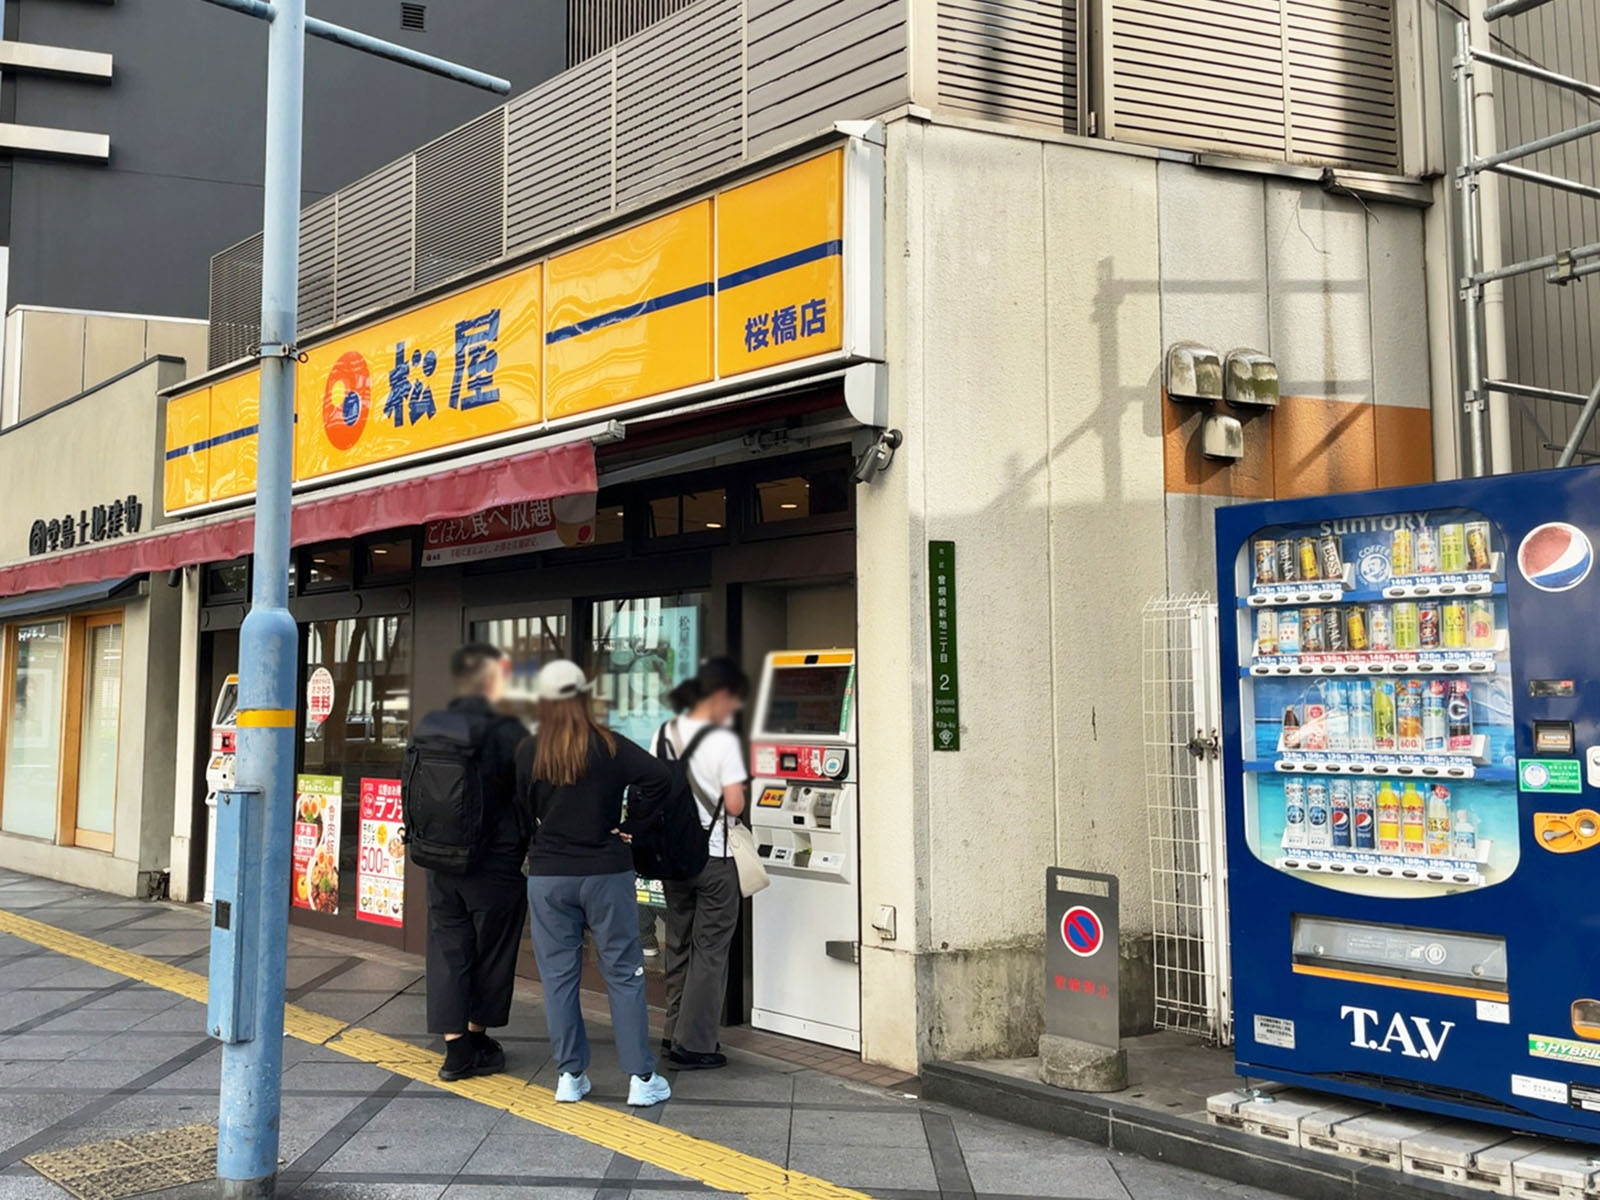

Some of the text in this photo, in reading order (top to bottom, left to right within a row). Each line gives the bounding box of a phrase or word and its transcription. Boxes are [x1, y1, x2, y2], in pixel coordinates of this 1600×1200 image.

[745, 298, 826, 352] 桜橋店
[384, 309, 500, 427] 松屋
[1320, 511, 1429, 536] SUNTORY
[939, 674, 950, 690] 2
[361, 846, 389, 875] 500円
